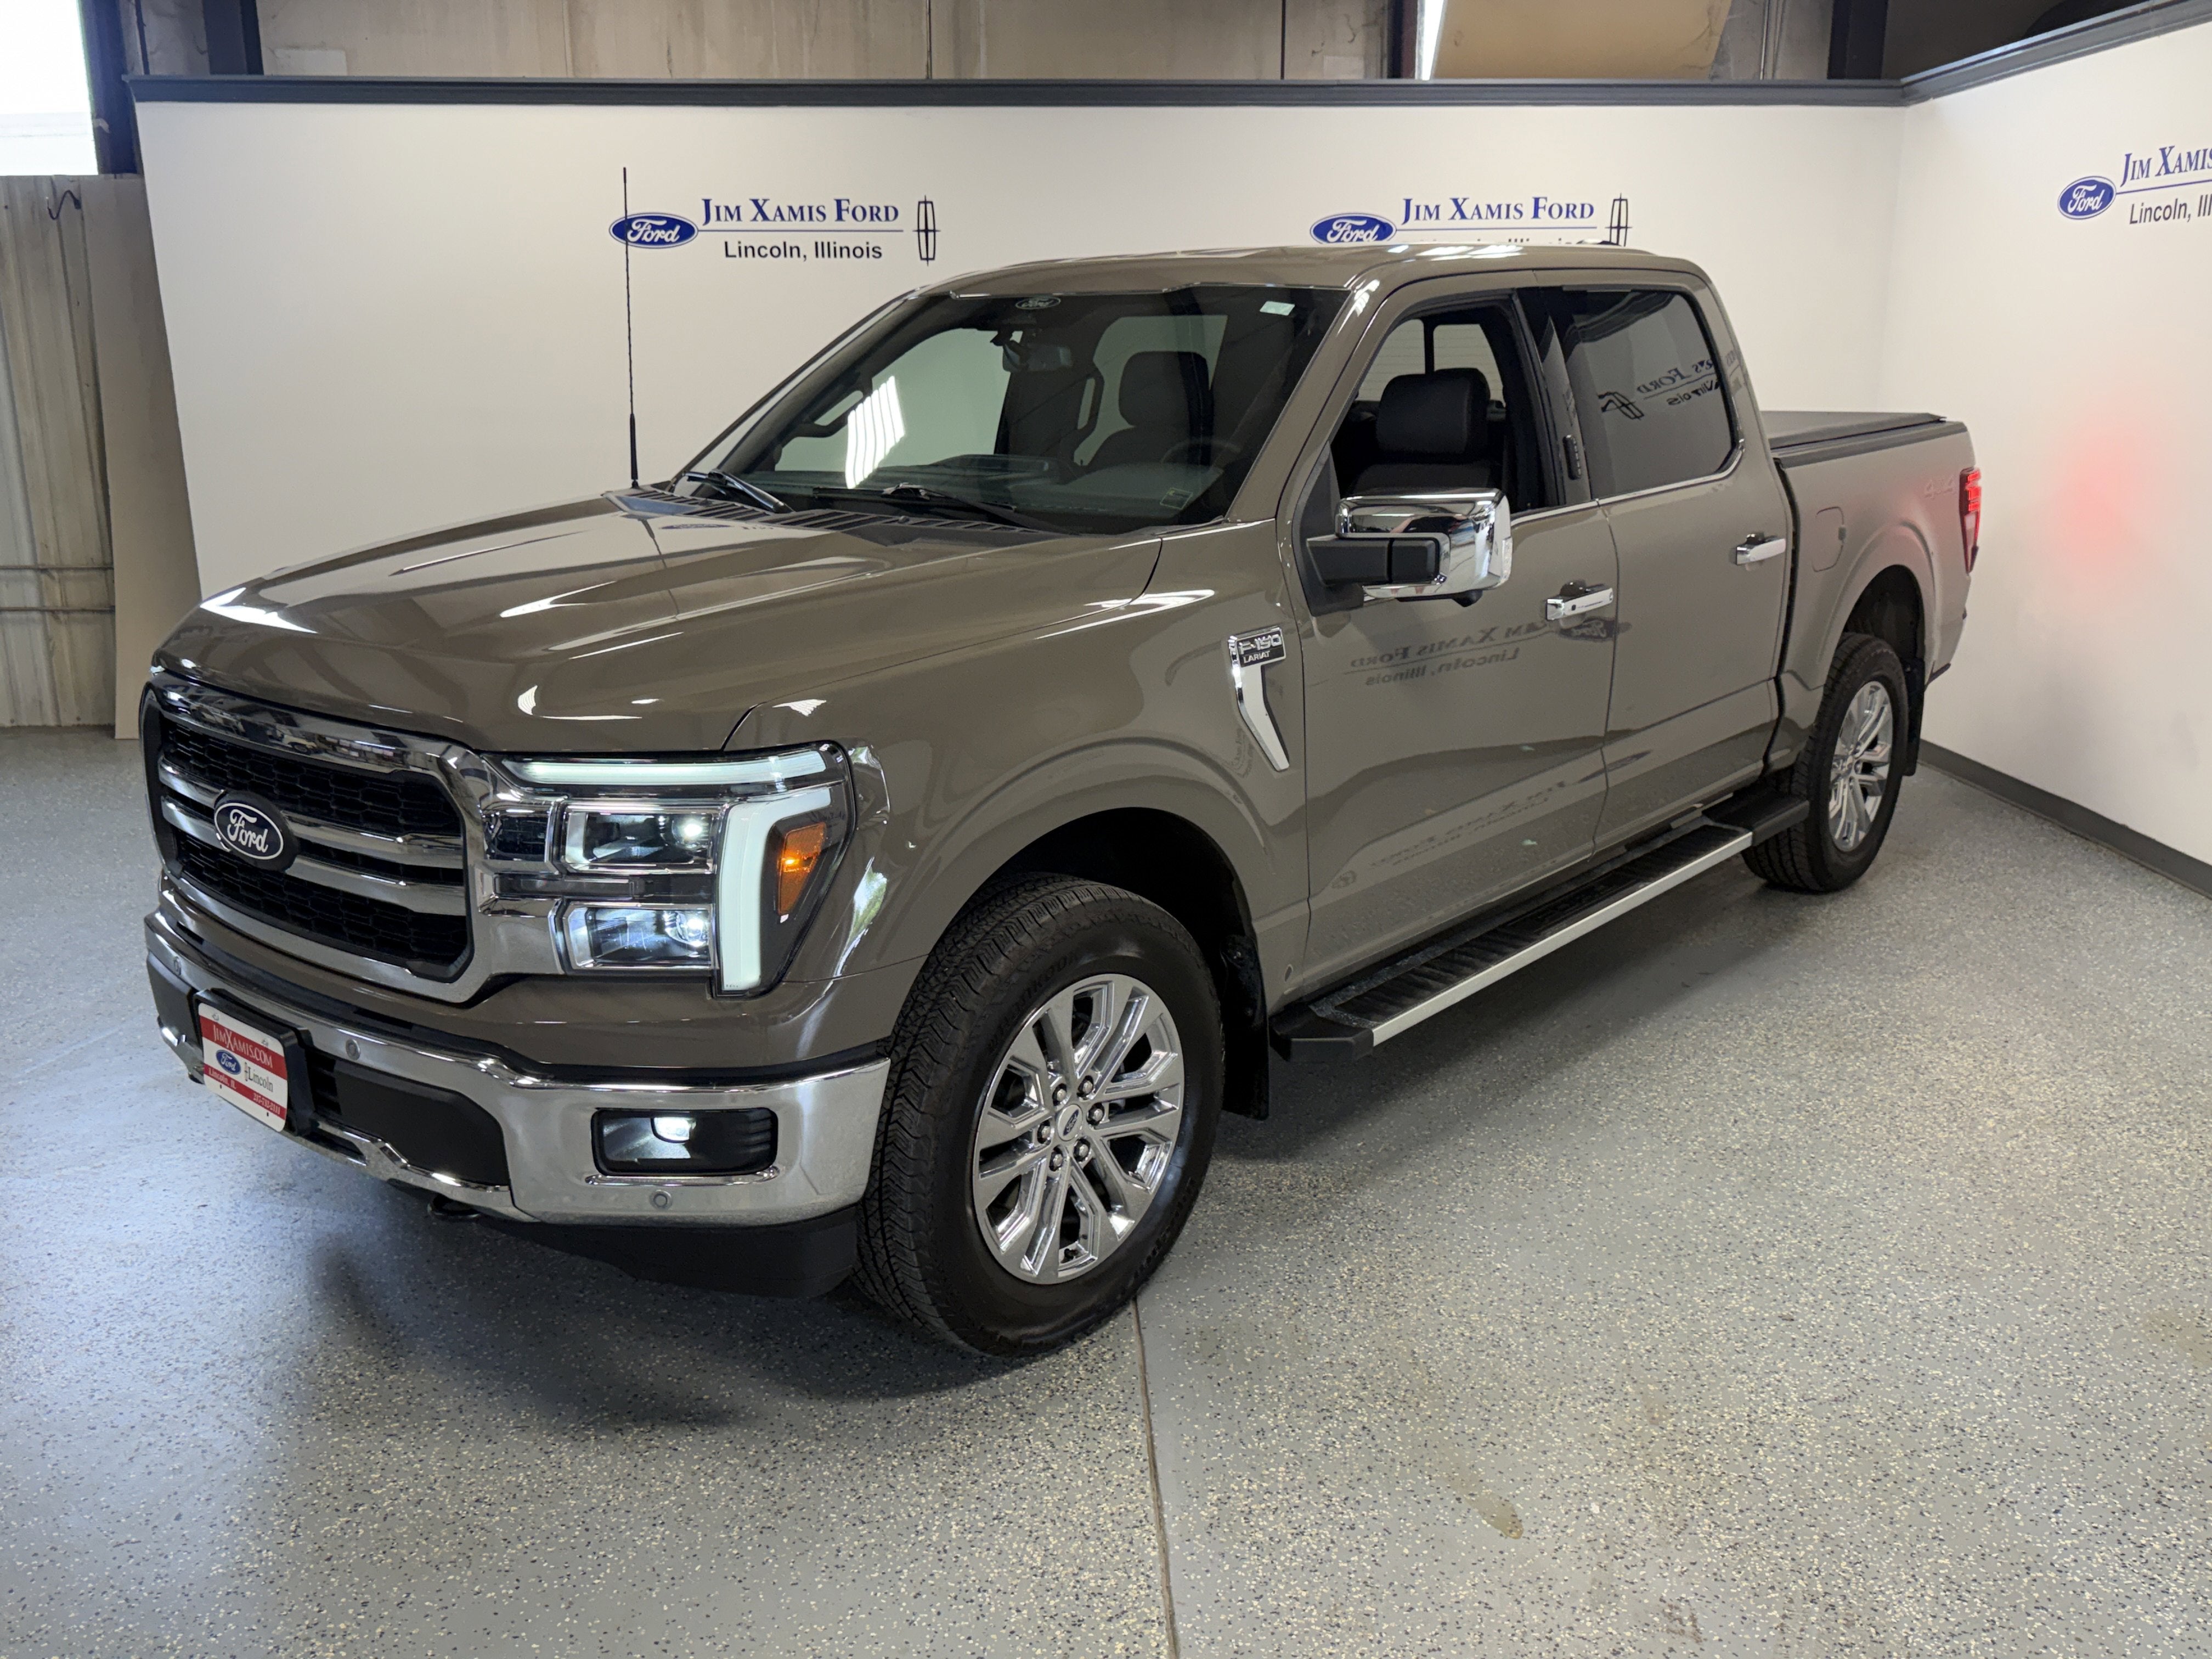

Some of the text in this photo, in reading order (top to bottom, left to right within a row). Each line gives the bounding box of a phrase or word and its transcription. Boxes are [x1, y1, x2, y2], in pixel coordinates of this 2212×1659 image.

[2120, 153, 2152, 187] JIM
[1401, 196, 1595, 225] JIM XAMIS FORD
[2067, 184, 2105, 213] Ford
[2129, 198, 2191, 224] Lincoln,
[702, 198, 899, 226] JIM XAMIS FORD
[627, 220, 680, 243] Ford
[1326, 219, 1380, 243] Ford
[725, 241, 883, 261] Lincoln, Illinois
[1243, 650, 1270, 663] LARIAT
[227, 809, 268, 853] Ford
[220, 1053, 236, 1071] Ford
[248, 1066, 273, 1092] Lincoln
